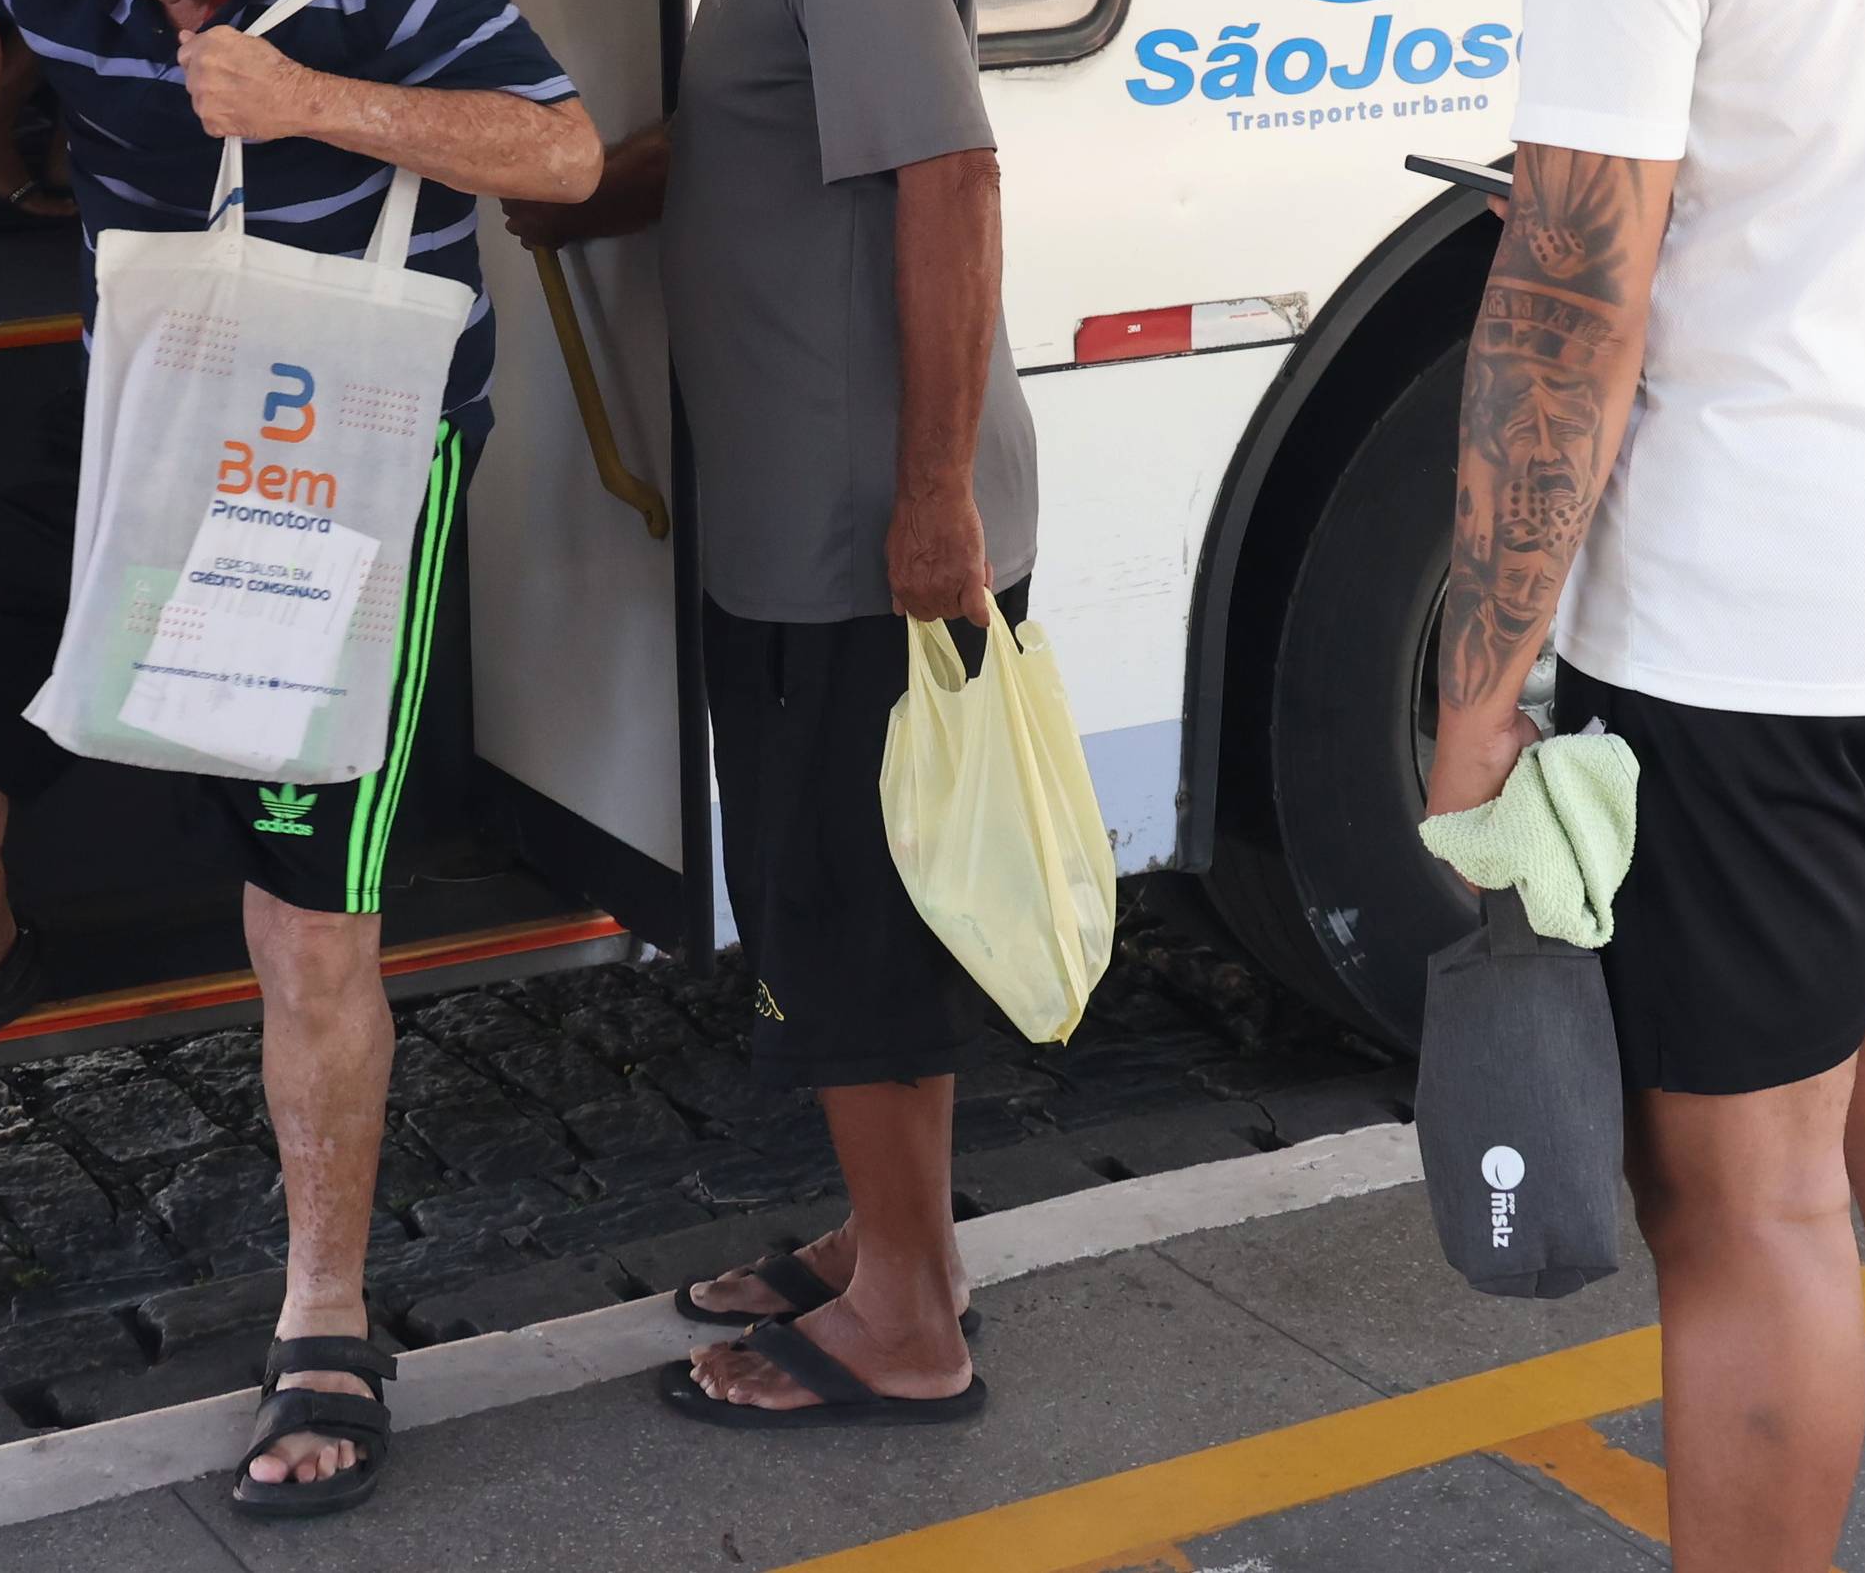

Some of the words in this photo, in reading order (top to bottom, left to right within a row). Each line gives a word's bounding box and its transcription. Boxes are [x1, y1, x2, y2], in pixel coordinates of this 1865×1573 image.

[1124, 14, 1524, 106] SãoJos
[1226, 101, 1384, 132] Transporte
[1392, 94, 1490, 117] urbano
[216, 440, 337, 508] Bem
[211, 499, 332, 533] Promotora
[189, 570, 243, 590] CRÉDITO
[246, 578, 332, 602] CONSIGNADO
[215, 556, 289, 579] ESPECIALISTA
[292, 568, 313, 582] EM
[253, 818, 314, 836] adidas
[1490, 1192, 1514, 1248] mslz
